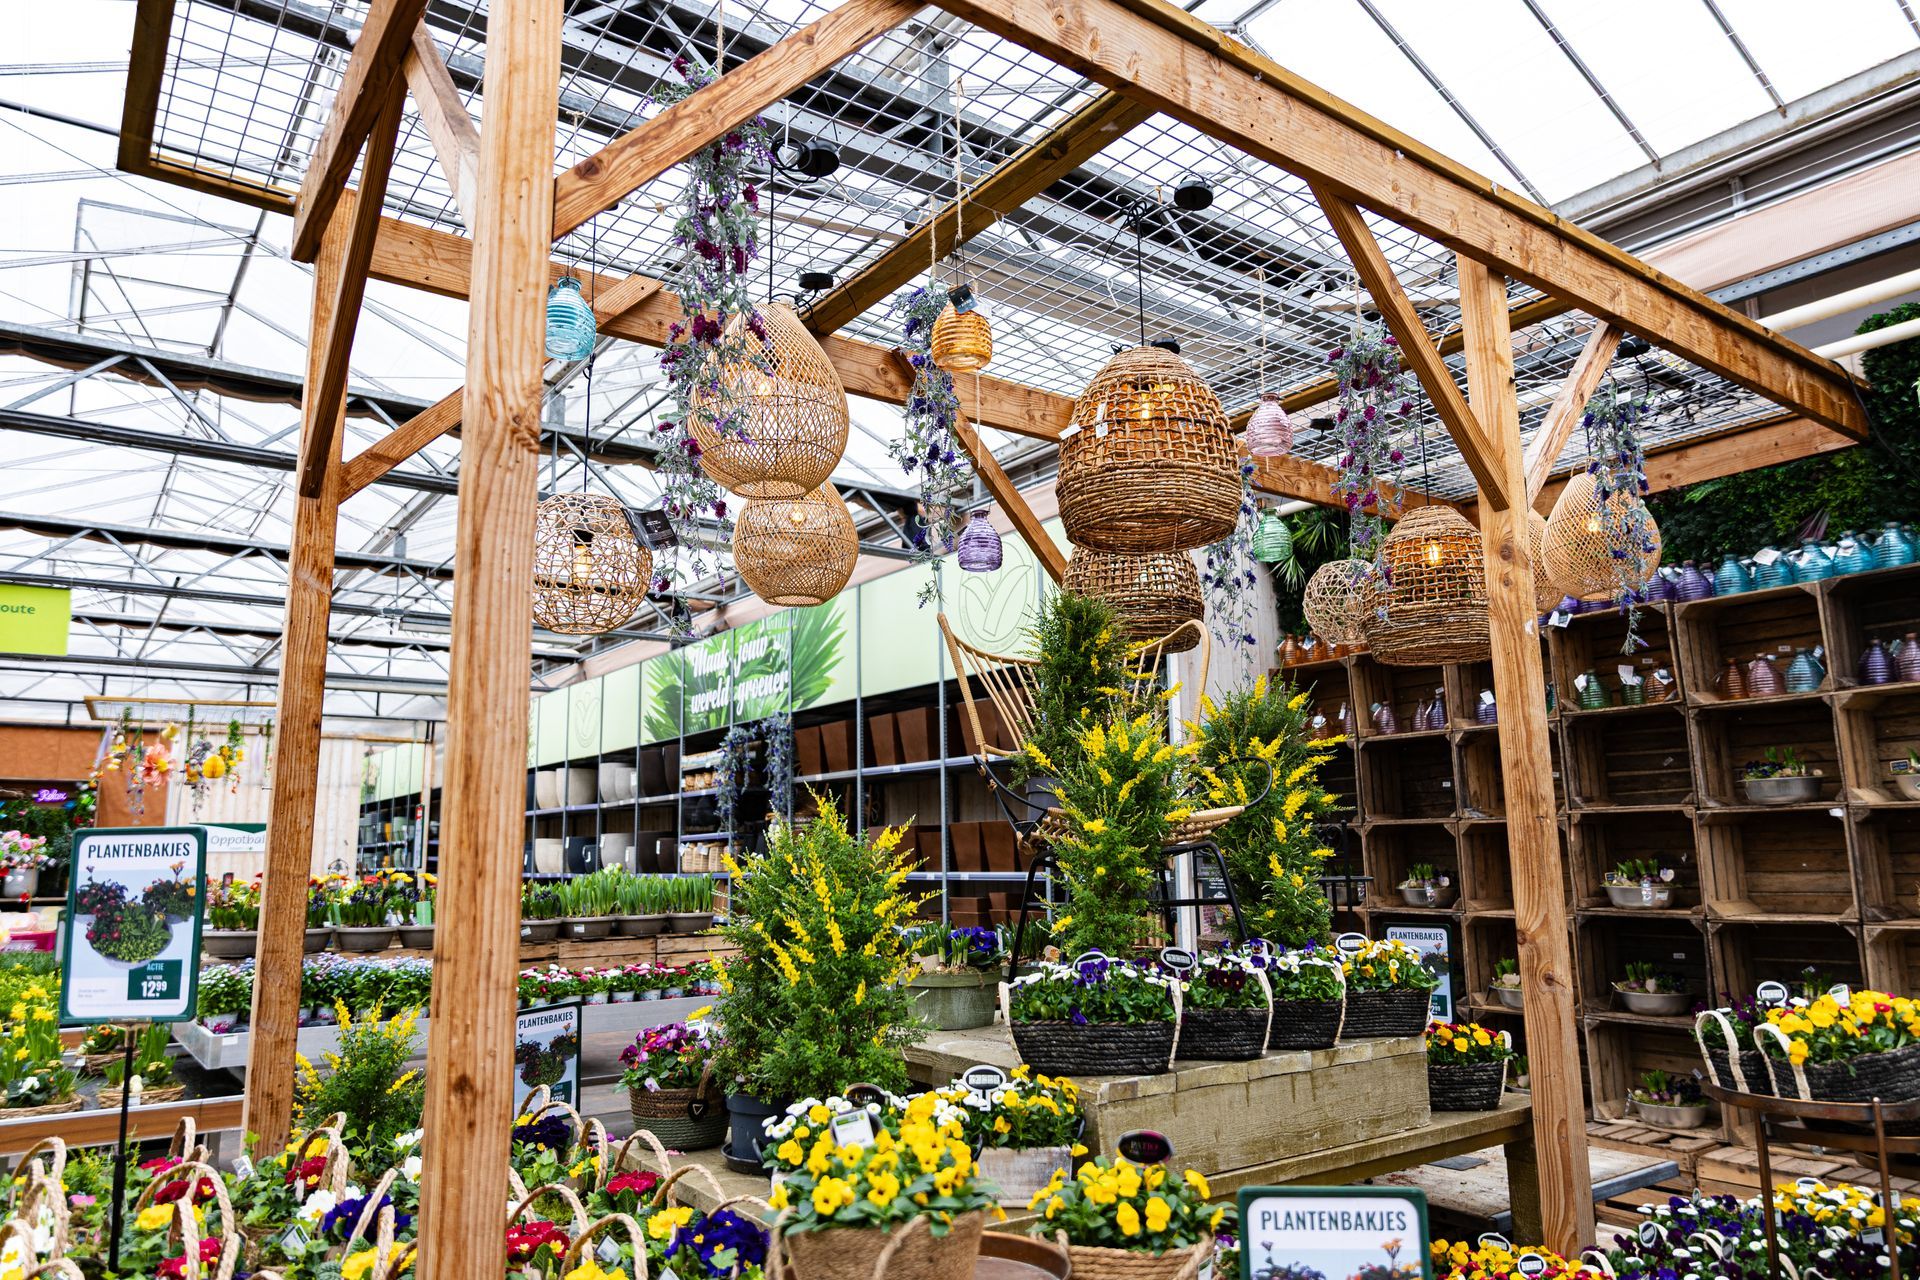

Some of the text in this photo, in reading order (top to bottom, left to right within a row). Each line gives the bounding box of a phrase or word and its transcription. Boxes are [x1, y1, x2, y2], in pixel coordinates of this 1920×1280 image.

[0, 604, 36, 614] oute
[692, 636, 768, 677] Maak jouw
[691, 670, 789, 716] wereld groener
[38, 788, 67, 801] Relax
[88, 842, 191, 858] PLANTENBAKJES
[1390, 931, 1444, 941] PLANTENBAKJES
[146, 962, 164, 971] ACTIE
[518, 1011, 573, 1029] PLANTENBAKJES
[1261, 1210, 1407, 1231] PLANTENBAKJES
